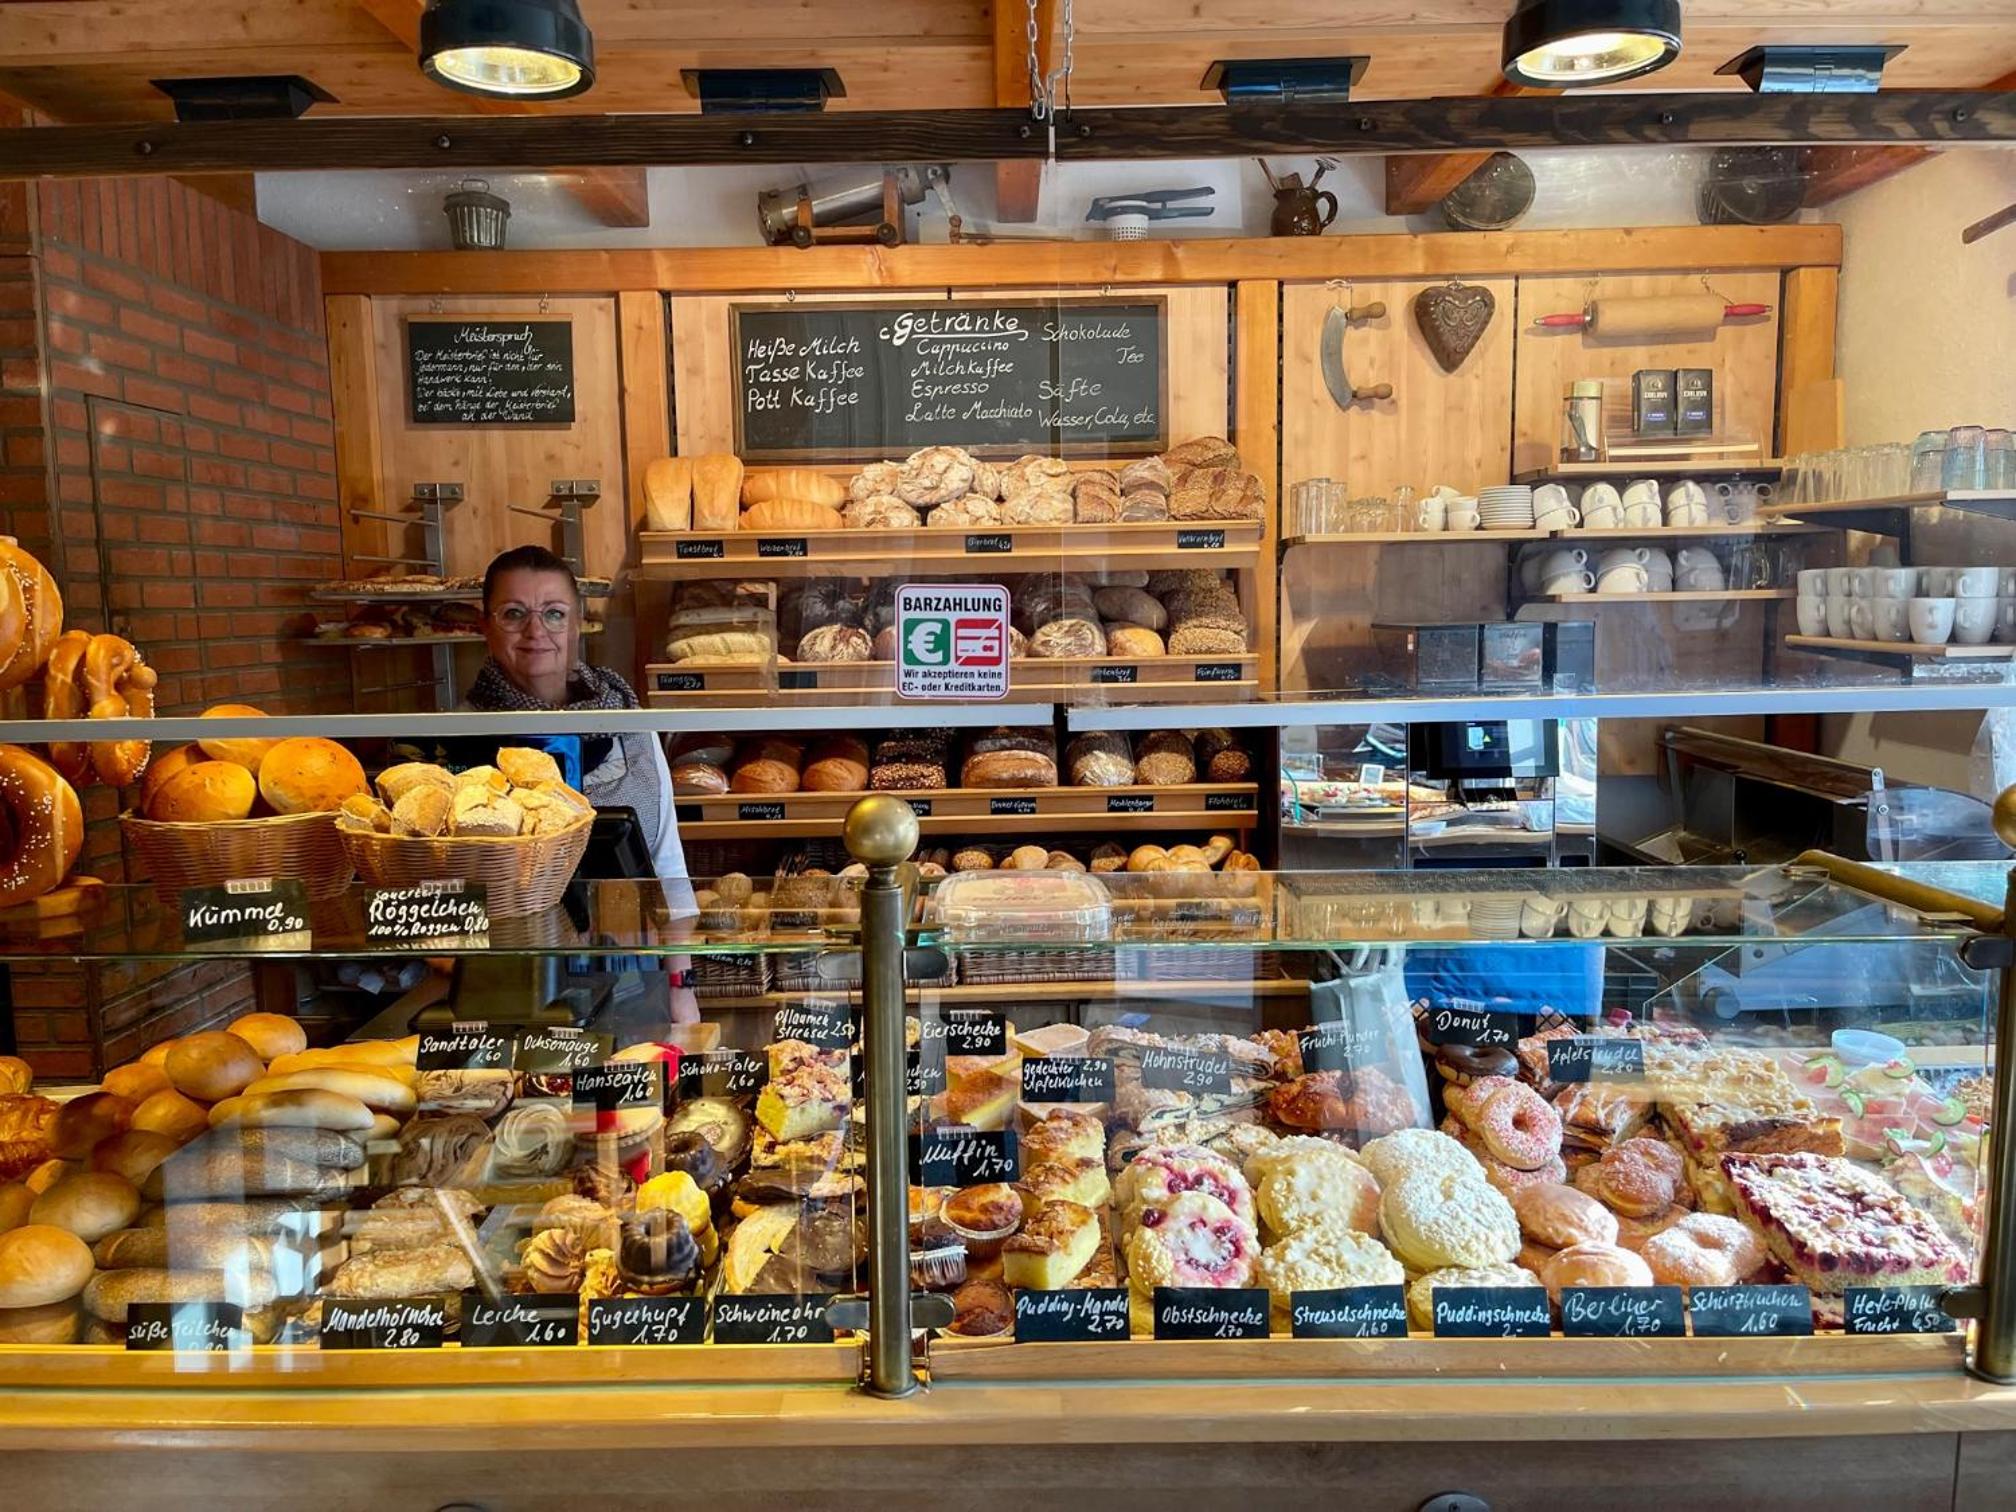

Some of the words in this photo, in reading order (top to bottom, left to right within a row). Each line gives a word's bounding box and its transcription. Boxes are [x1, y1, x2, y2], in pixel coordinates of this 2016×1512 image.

[880, 310, 1020, 346] Getränke
[1041, 321, 1132, 341] Schokolade
[453, 325, 533, 354] Meisterspruch
[747, 337, 796, 363] Heiße
[799, 336, 861, 356] Milch
[917, 339, 1009, 361] Cappuccino
[414, 349, 433, 361] Der
[1116, 345, 1146, 365] Tee
[745, 362, 800, 384] Tasse
[805, 360, 864, 384] Kaffee
[911, 358, 1014, 378] Milchkaffee
[748, 387, 781, 412] Pott
[790, 386, 859, 413] Kaffee
[911, 379, 989, 400] Espresso
[1038, 378, 1103, 402] Säfte
[905, 402, 956, 422] Latte
[903, 597, 1002, 612] BARZAHLUNG
[903, 669, 919, 679] Wir
[921, 669, 975, 680] akzeptieren
[977, 669, 1002, 679] keine
[902, 682, 918, 692] EC-
[921, 682, 941, 692] oder
[944, 682, 1004, 692] Kreditkarten.
[189, 902, 285, 928] Kümmel
[368, 898, 482, 924] Röggelchen
[267, 917, 303, 934] 0,90
[368, 924, 409, 936] 100%
[410, 922, 461, 936] Roggen
[923, 1020, 1002, 1040] Eierschecke
[1436, 1010, 1491, 1031] Donut
[421, 1034, 505, 1053] Sandtaler
[523, 1034, 600, 1054] Ochsenauge
[1142, 1049, 1227, 1075] Mohnstrudel
[1551, 1046, 1640, 1066] Apfelstrudel
[679, 1057, 764, 1078] Schoko-Taler
[1024, 1059, 1075, 1081] gedeckter
[576, 1067, 657, 1091] Hanseaten
[1024, 1073, 1103, 1093] Apfelkuchen
[919, 1140, 998, 1166] Muffin
[972, 1158, 1013, 1177] 1,70
[472, 1304, 541, 1325] Lerche
[715, 1303, 825, 1323] Schweineohr
[1016, 1291, 1129, 1322] Pudding-Mandel
[1162, 1306, 1264, 1325] Obstschnecke
[1294, 1302, 1407, 1326] Streuselschnecke
[1436, 1301, 1551, 1327] Puddingschnecke
[1565, 1292, 1663, 1322] Berliner
[323, 1304, 443, 1333] Mandelhörnchen
[590, 1303, 691, 1335] Gugelhupf
[1853, 1316, 1900, 1332] Frucht
[128, 1321, 168, 1341] süße
[631, 1326, 678, 1345] 1,70
